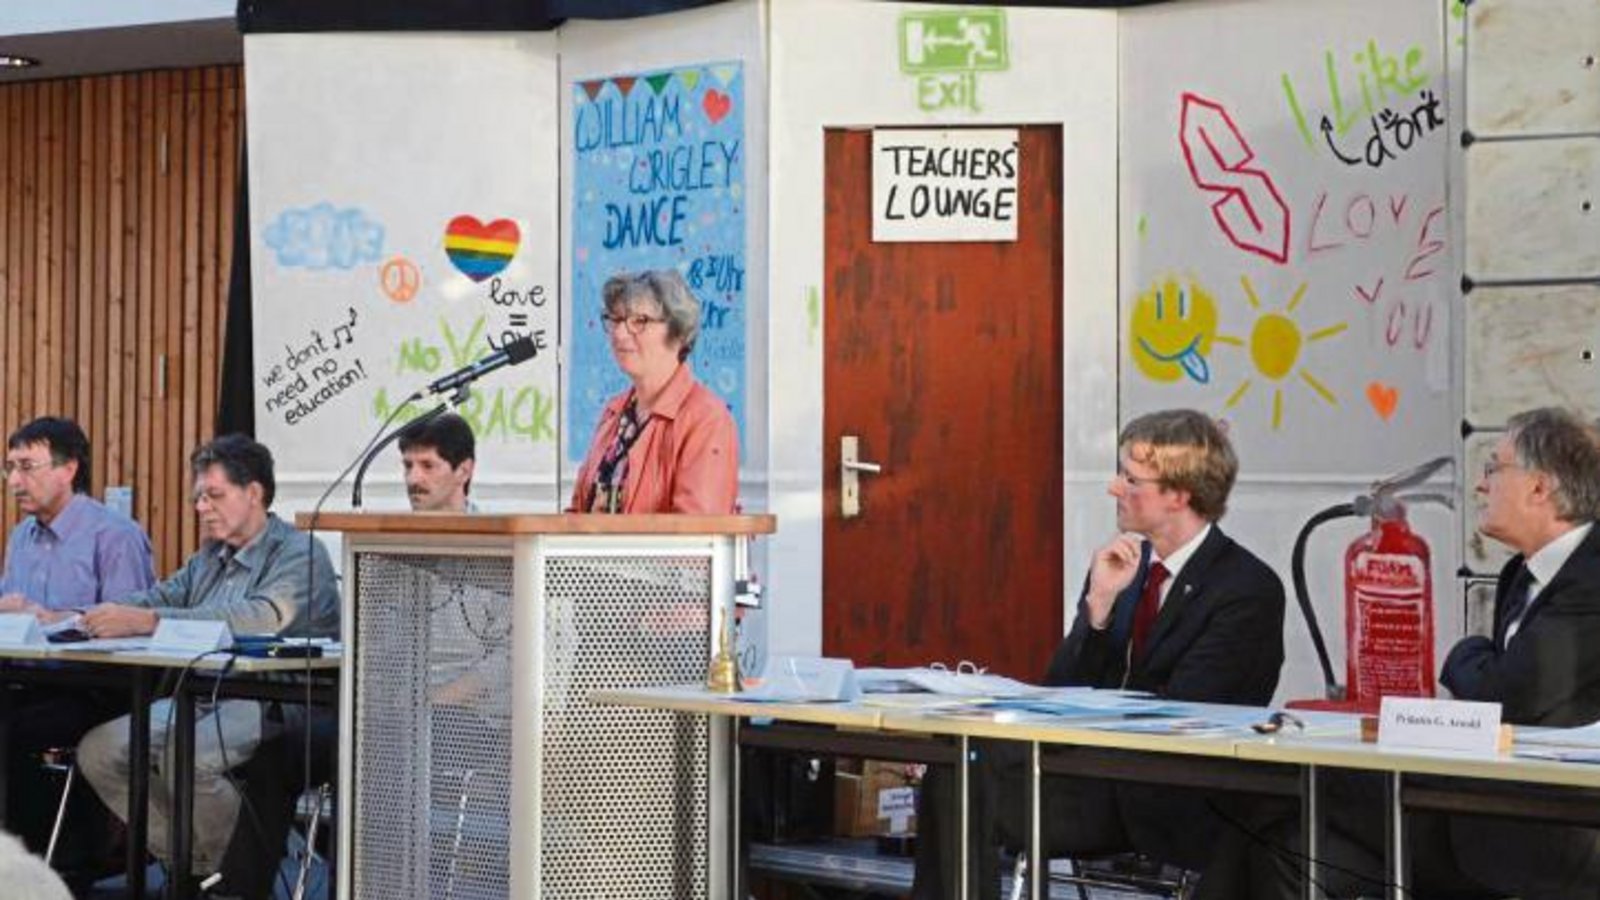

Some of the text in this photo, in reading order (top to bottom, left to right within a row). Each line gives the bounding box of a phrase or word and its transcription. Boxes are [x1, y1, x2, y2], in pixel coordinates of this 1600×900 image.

[916, 71, 982, 113] Exit
[575, 94, 682, 153] WILLIAM
[628, 138, 740, 194] WRIGLEY
[602, 196, 689, 249] DANCE
[885, 184, 1016, 220] LOUNGE
[490, 277, 547, 307] love
[265, 358, 338, 412] need no
[284, 358, 368, 426] education!
